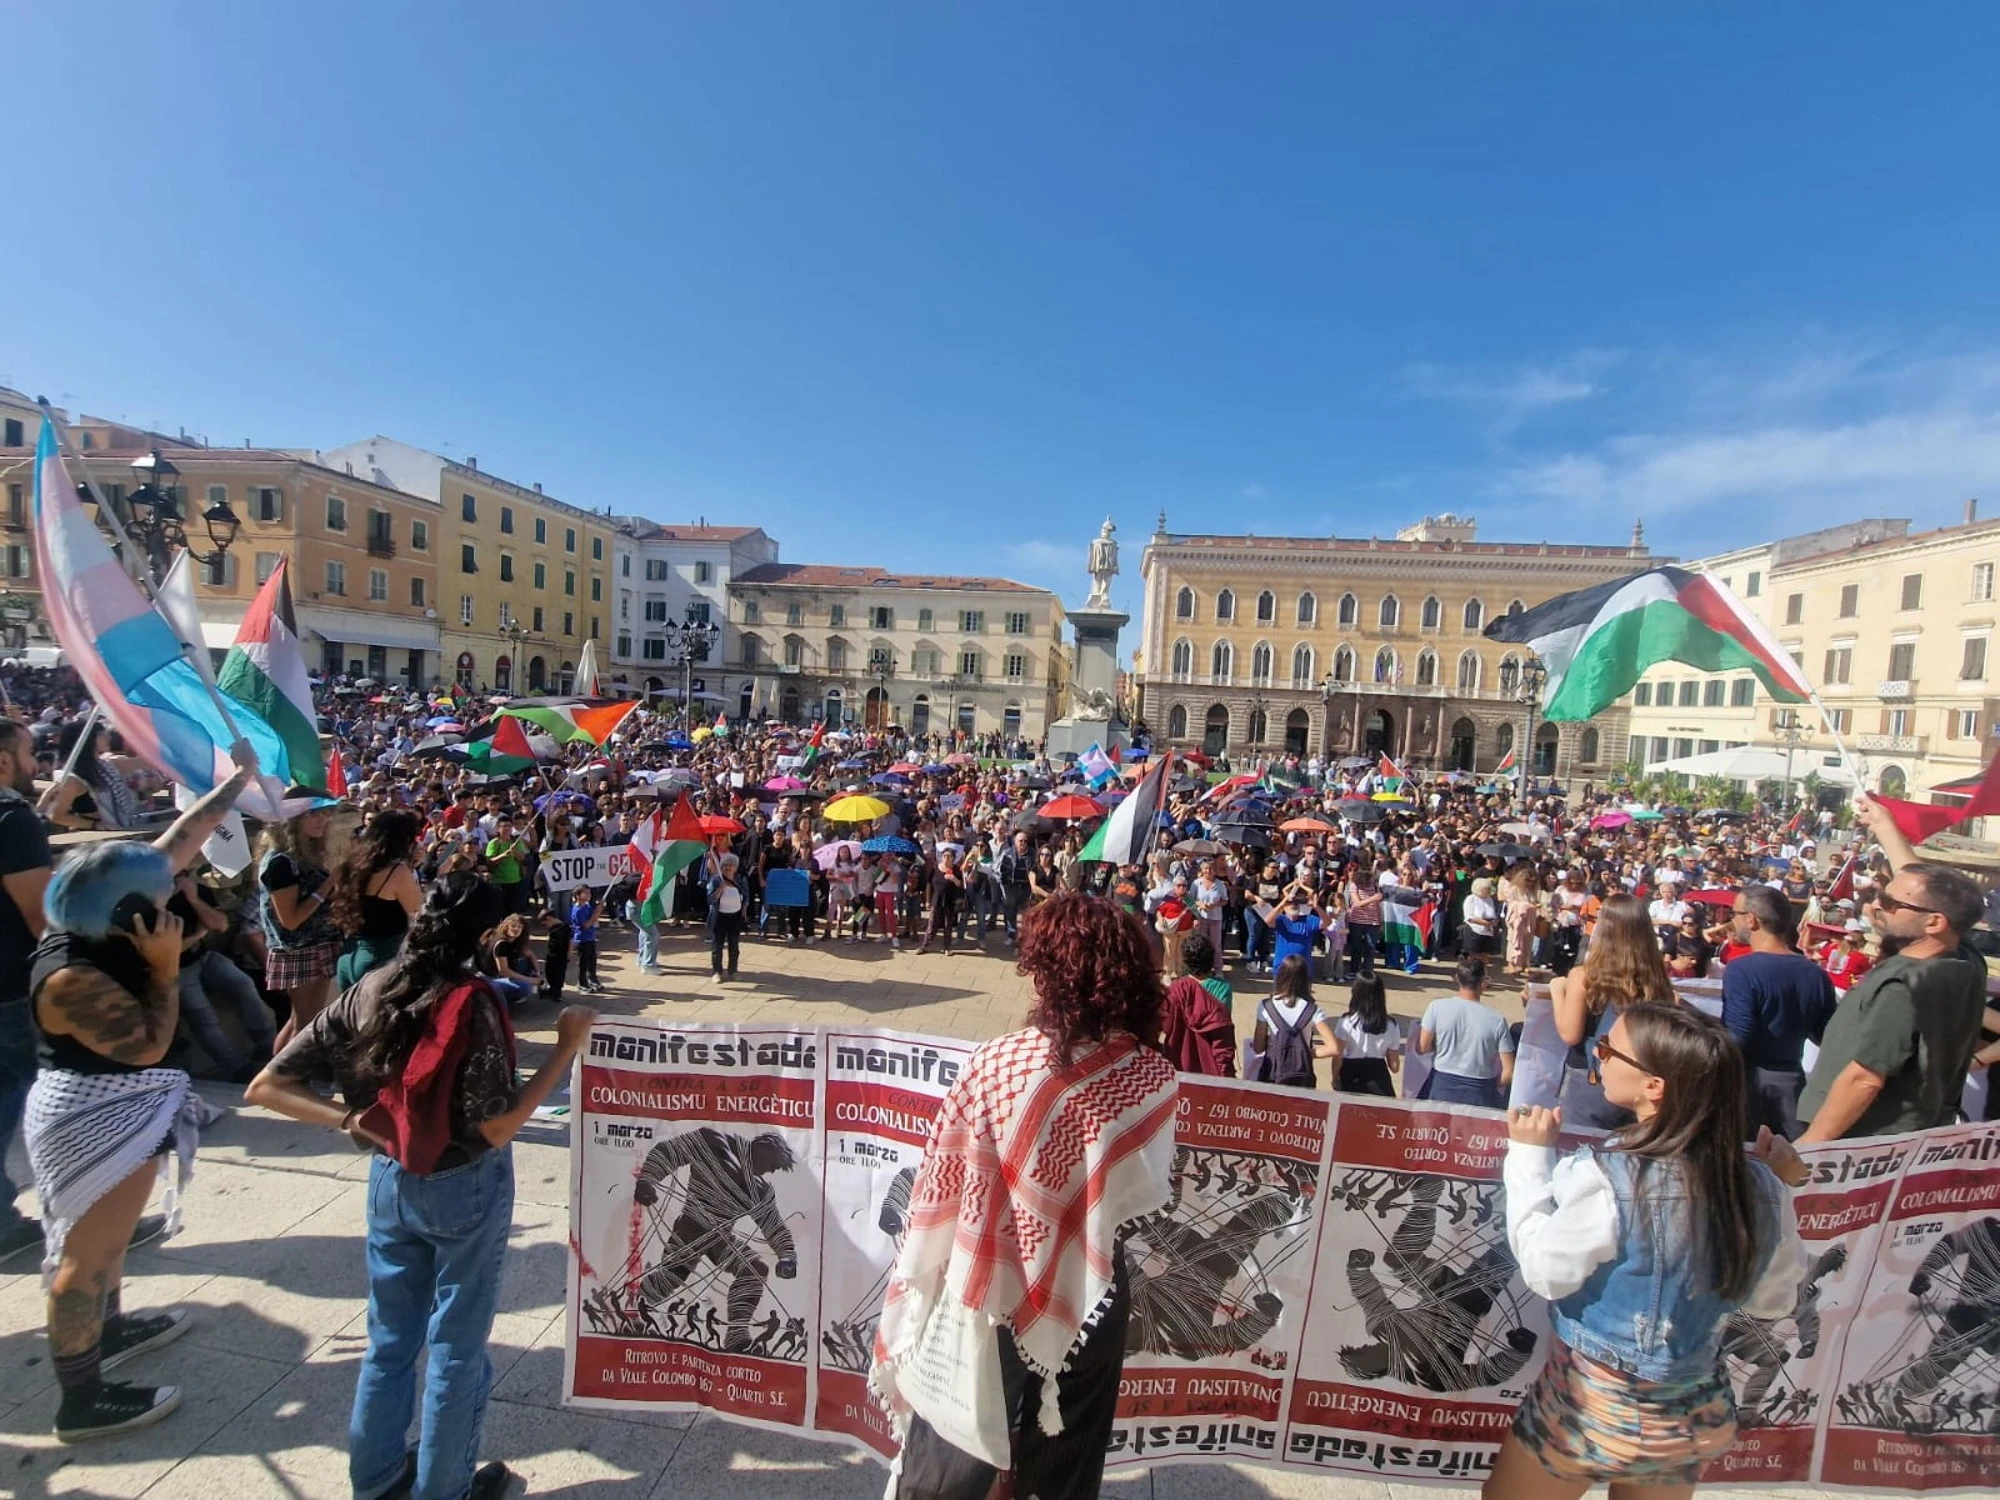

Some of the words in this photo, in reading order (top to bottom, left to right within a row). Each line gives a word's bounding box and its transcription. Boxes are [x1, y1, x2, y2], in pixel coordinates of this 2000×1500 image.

[551, 856, 595, 882] STOP
[590, 1086, 706, 1111] COLONIALISMU
[716, 1093, 816, 1119] ENERGÈTICU
[1209, 1103, 1230, 1119] 167
[1235, 1105, 1289, 1128] COLOMBO
[607, 1124, 654, 1140] marzo
[1196, 1123, 1251, 1140] PARTENZA
[1270, 1130, 1322, 1155] RITROVO
[1402, 1126, 1449, 1146] QUARTU
[1467, 1134, 1490, 1152] 167
[839, 1138, 846, 1153] 1
[854, 1141, 899, 1164] marzo
[1404, 1147, 1448, 1162] CORTEO
[1900, 1183, 2000, 1210] COLONIALISMU
[1799, 1200, 1881, 1231] ENERGÈTICU
[624, 1348, 668, 1364] RITROVO
[671, 1352, 678, 1364] E
[681, 1355, 722, 1377] PARTENZA
[726, 1365, 762, 1384] CORTEO
[602, 1368, 615, 1383] DA
[620, 1367, 648, 1384] VIALE
[652, 1369, 697, 1387] COLOMBO
[700, 1376, 714, 1394] 167
[726, 1383, 766, 1405] QUARTU
[1306, 1390, 1421, 1422] ENERGÈTICU
